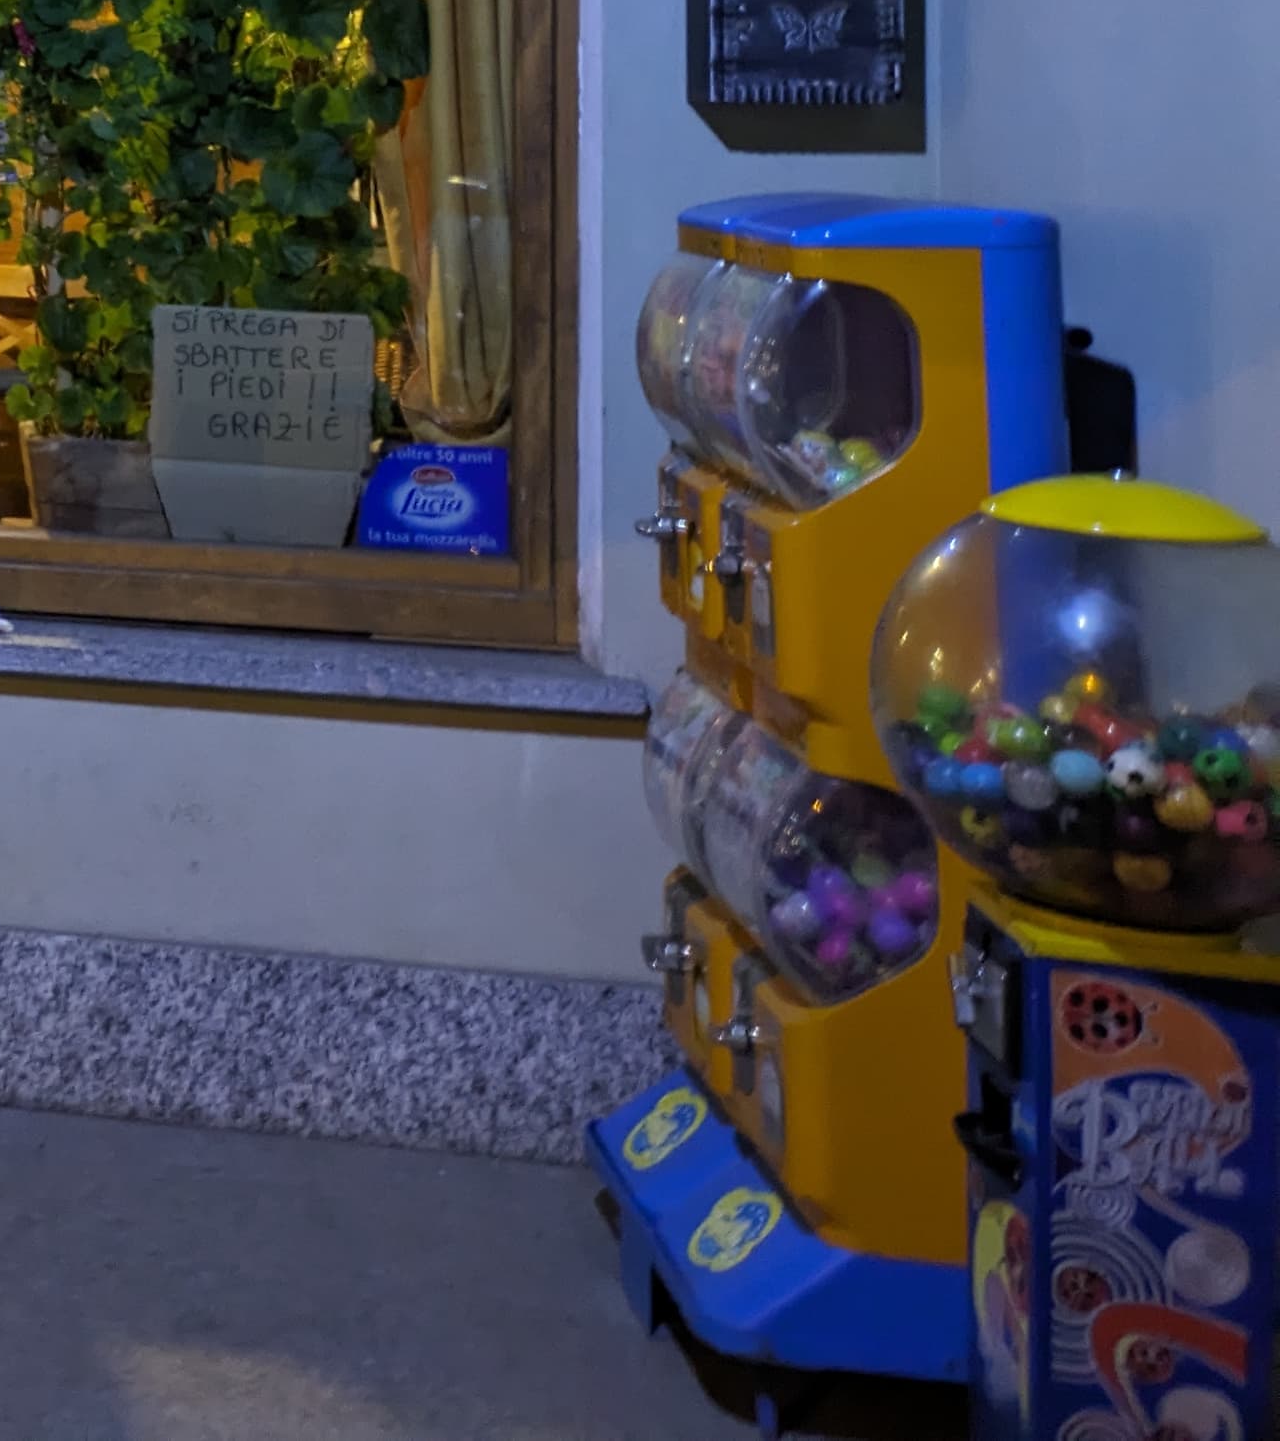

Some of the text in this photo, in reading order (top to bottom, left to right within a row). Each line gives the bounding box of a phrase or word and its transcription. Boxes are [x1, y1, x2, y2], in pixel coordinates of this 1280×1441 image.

[206, 309, 298, 337] PREGA
[173, 342, 338, 370] SBATTERE
[458, 450, 493, 464] anni
[400, 488, 463, 517] Lucia
[385, 529, 409, 543] tua
